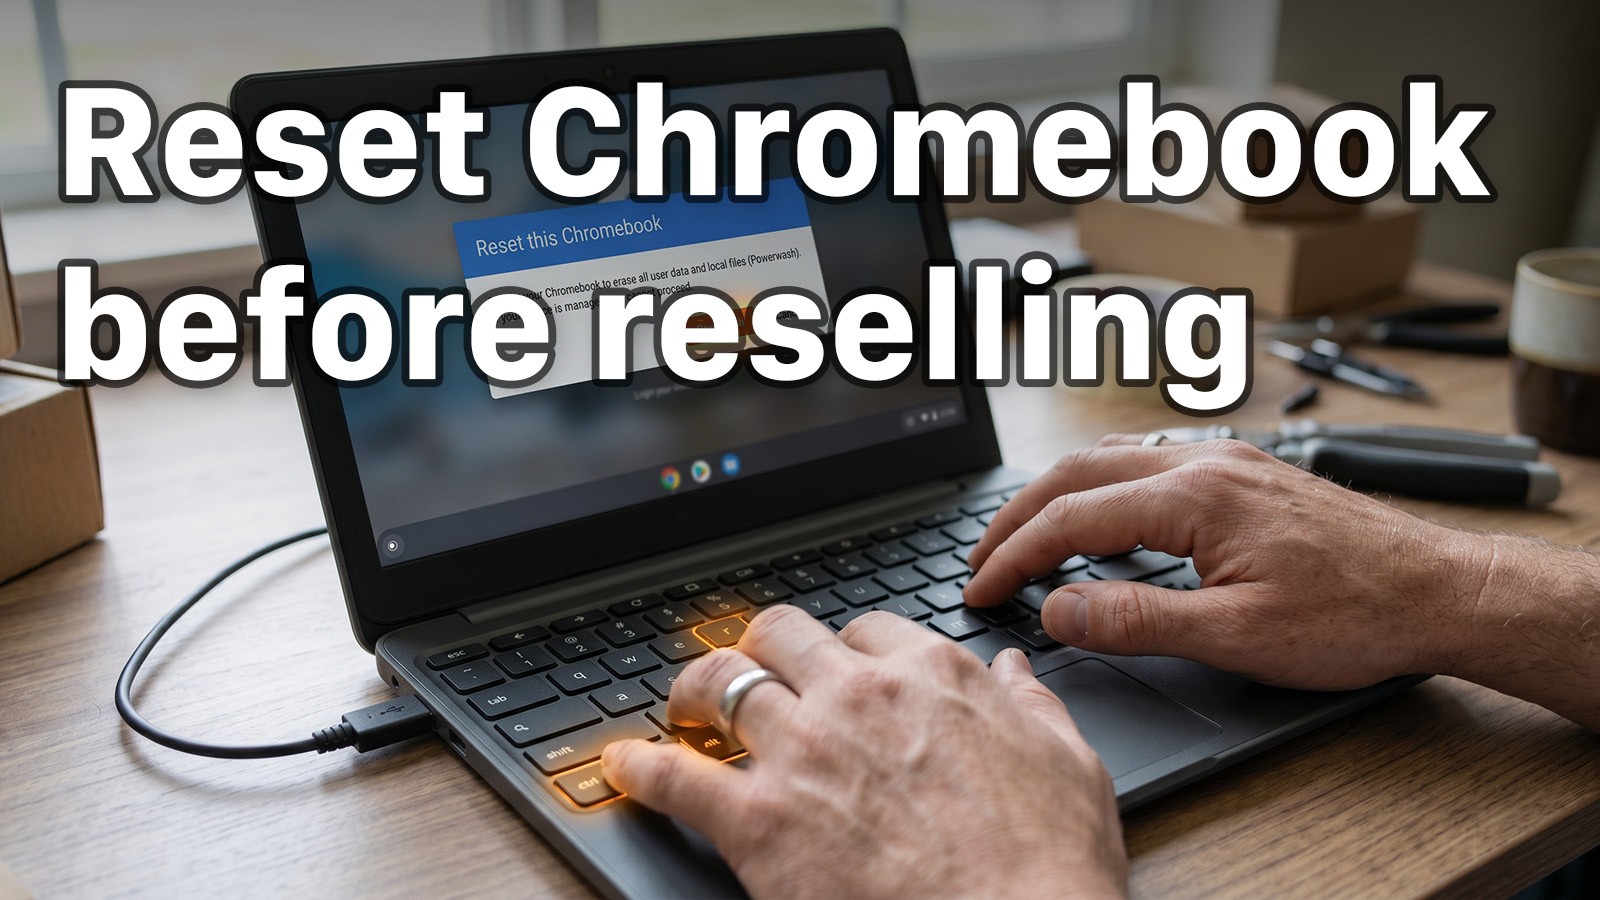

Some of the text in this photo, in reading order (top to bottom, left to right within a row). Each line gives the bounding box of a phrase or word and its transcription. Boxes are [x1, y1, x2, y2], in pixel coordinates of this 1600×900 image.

[475, 214, 663, 257] Reset this Chromebook
[545, 281, 602, 298] Chromebook
[602, 280, 612, 290] to
[613, 277, 637, 288] erase
[638, 272, 649, 283] all
[650, 270, 668, 281] user
[670, 266, 689, 278] data
[691, 262, 706, 275] and
[707, 258, 728, 272] local
[729, 256, 747, 269] files
[747, 247, 802, 268] (Powerwash).
[554, 304, 563, 313] is
[565, 298, 600, 312] manage
[657, 282, 694, 299] proceed.
[854, 587, 866, 595] u
[718, 602, 731, 611] 5
[810, 600, 822, 610] y
[674, 615, 685, 624] 4
[950, 619, 968, 629] m
[623, 629, 636, 639] 3
[722, 627, 733, 636] r
[564, 635, 578, 645] @
[575, 644, 588, 653] 2
[674, 641, 686, 650] e
[447, 649, 467, 660] esc
[621, 654, 638, 665] w
[524, 659, 534, 667] 1
[573, 671, 588, 680] q
[487, 694, 508, 706] tab
[615, 692, 629, 702] a
[704, 737, 722, 749] alt
[546, 745, 575, 761] shift
[577, 776, 600, 791] ctrl
